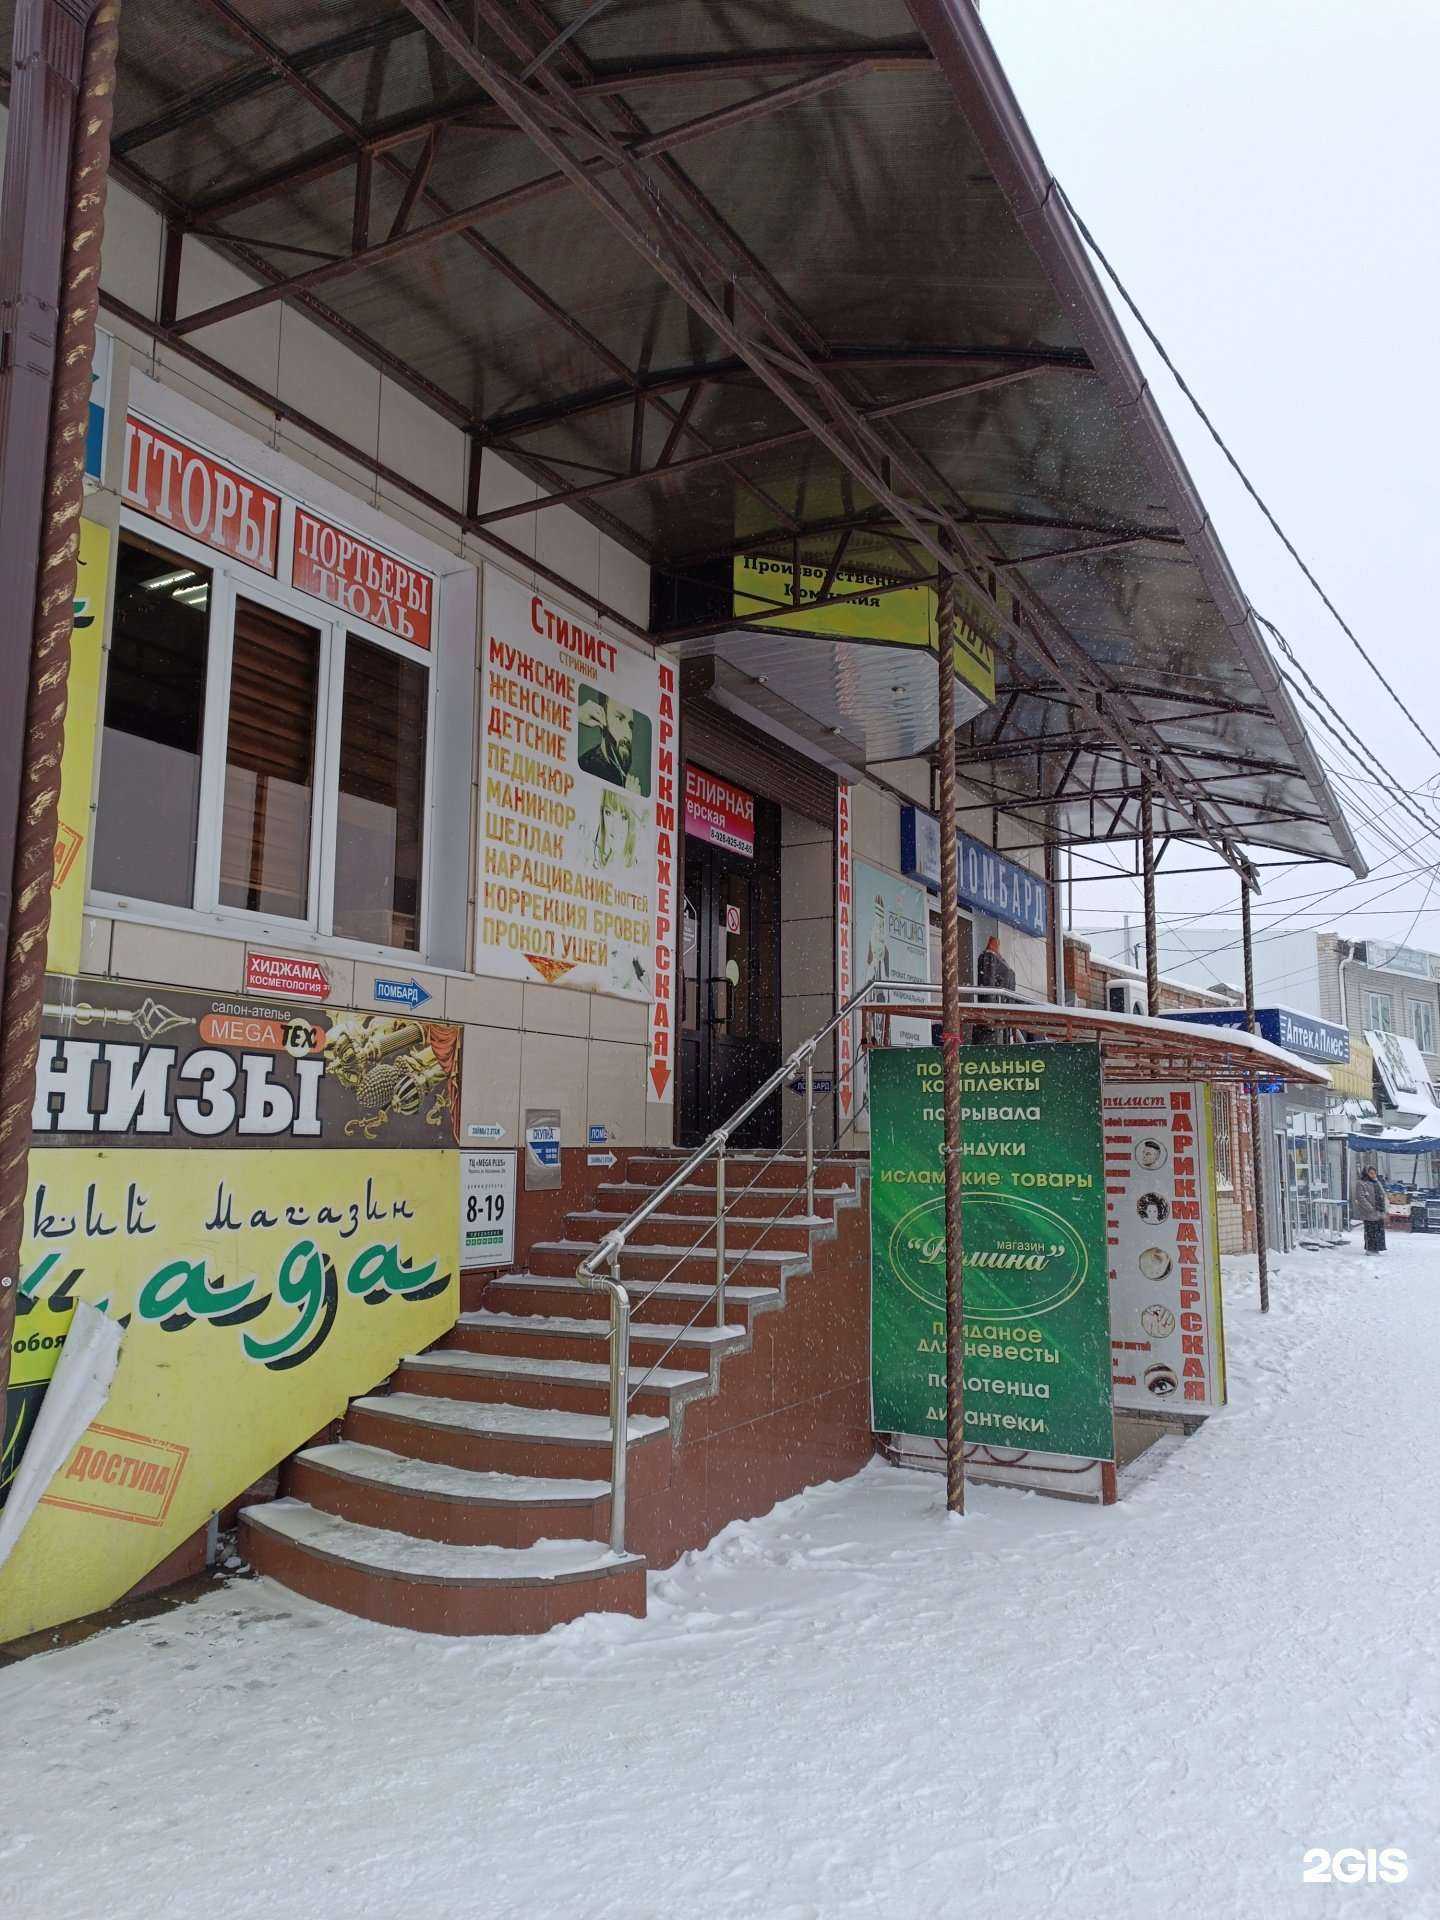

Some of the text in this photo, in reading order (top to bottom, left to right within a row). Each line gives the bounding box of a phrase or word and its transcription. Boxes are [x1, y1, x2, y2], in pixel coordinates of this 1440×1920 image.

[299, 514, 428, 615] ПОРТЬЕРЫ
[313, 564, 415, 639] ТЮЛЬ
[489, 636, 576, 703] МУЖСКИЕ
[559, 650, 598, 681] СТРИЖКИ
[488, 669, 572, 733] ЖЕНСКИЕ
[487, 705, 567, 762] ДЕТСКИЕ
[487, 742, 575, 798] ПЕДИКЮР
[486, 777, 576, 830] МАНИКЮР
[685, 797, 726, 828] ерская
[485, 811, 564, 860] ШЕЛЛАК
[485, 846, 614, 907] НАРАЩИВАНИЕ
[654, 663, 675, 1057] ПАРИКМАХЕРСКАЯ
[484, 881, 650, 947] КОРРЕКЦИЯ БРОВЕЙ
[483, 916, 608, 967] ПРОКОЛ УШЕЙ
[249, 975, 321, 992] КОСМЕТОЛОГИЯ
[251, 957, 322, 981] ХИДЖАМА
[211, 1000, 291, 1021] салон-ателье
[378, 983, 418, 1002] ЛОМБАРД
[211, 1019, 276, 1043] MEGA
[916, 1059, 1046, 1076] потельные
[922, 1077, 1040, 1093] коплекты
[31, 1038, 325, 1138] НИЗЫ
[923, 1106, 1042, 1121] порывала
[938, 1141, 1027, 1157] сндуки
[881, 1168, 1001, 1187] исламкие
[1012, 1172, 1093, 1189] товары
[34, 1183, 156, 1239] кий
[467, 1194, 504, 1223] 8-19
[996, 1240, 1045, 1252] магазин
[1169, 1090, 1208, 1402] ПАРИКМАХЕРСКАЯ
[964, 1342, 1060, 1364] невесты
[926, 1406, 1046, 1434] диантеки
[65, 1446, 172, 1496] ДОСТУПА
